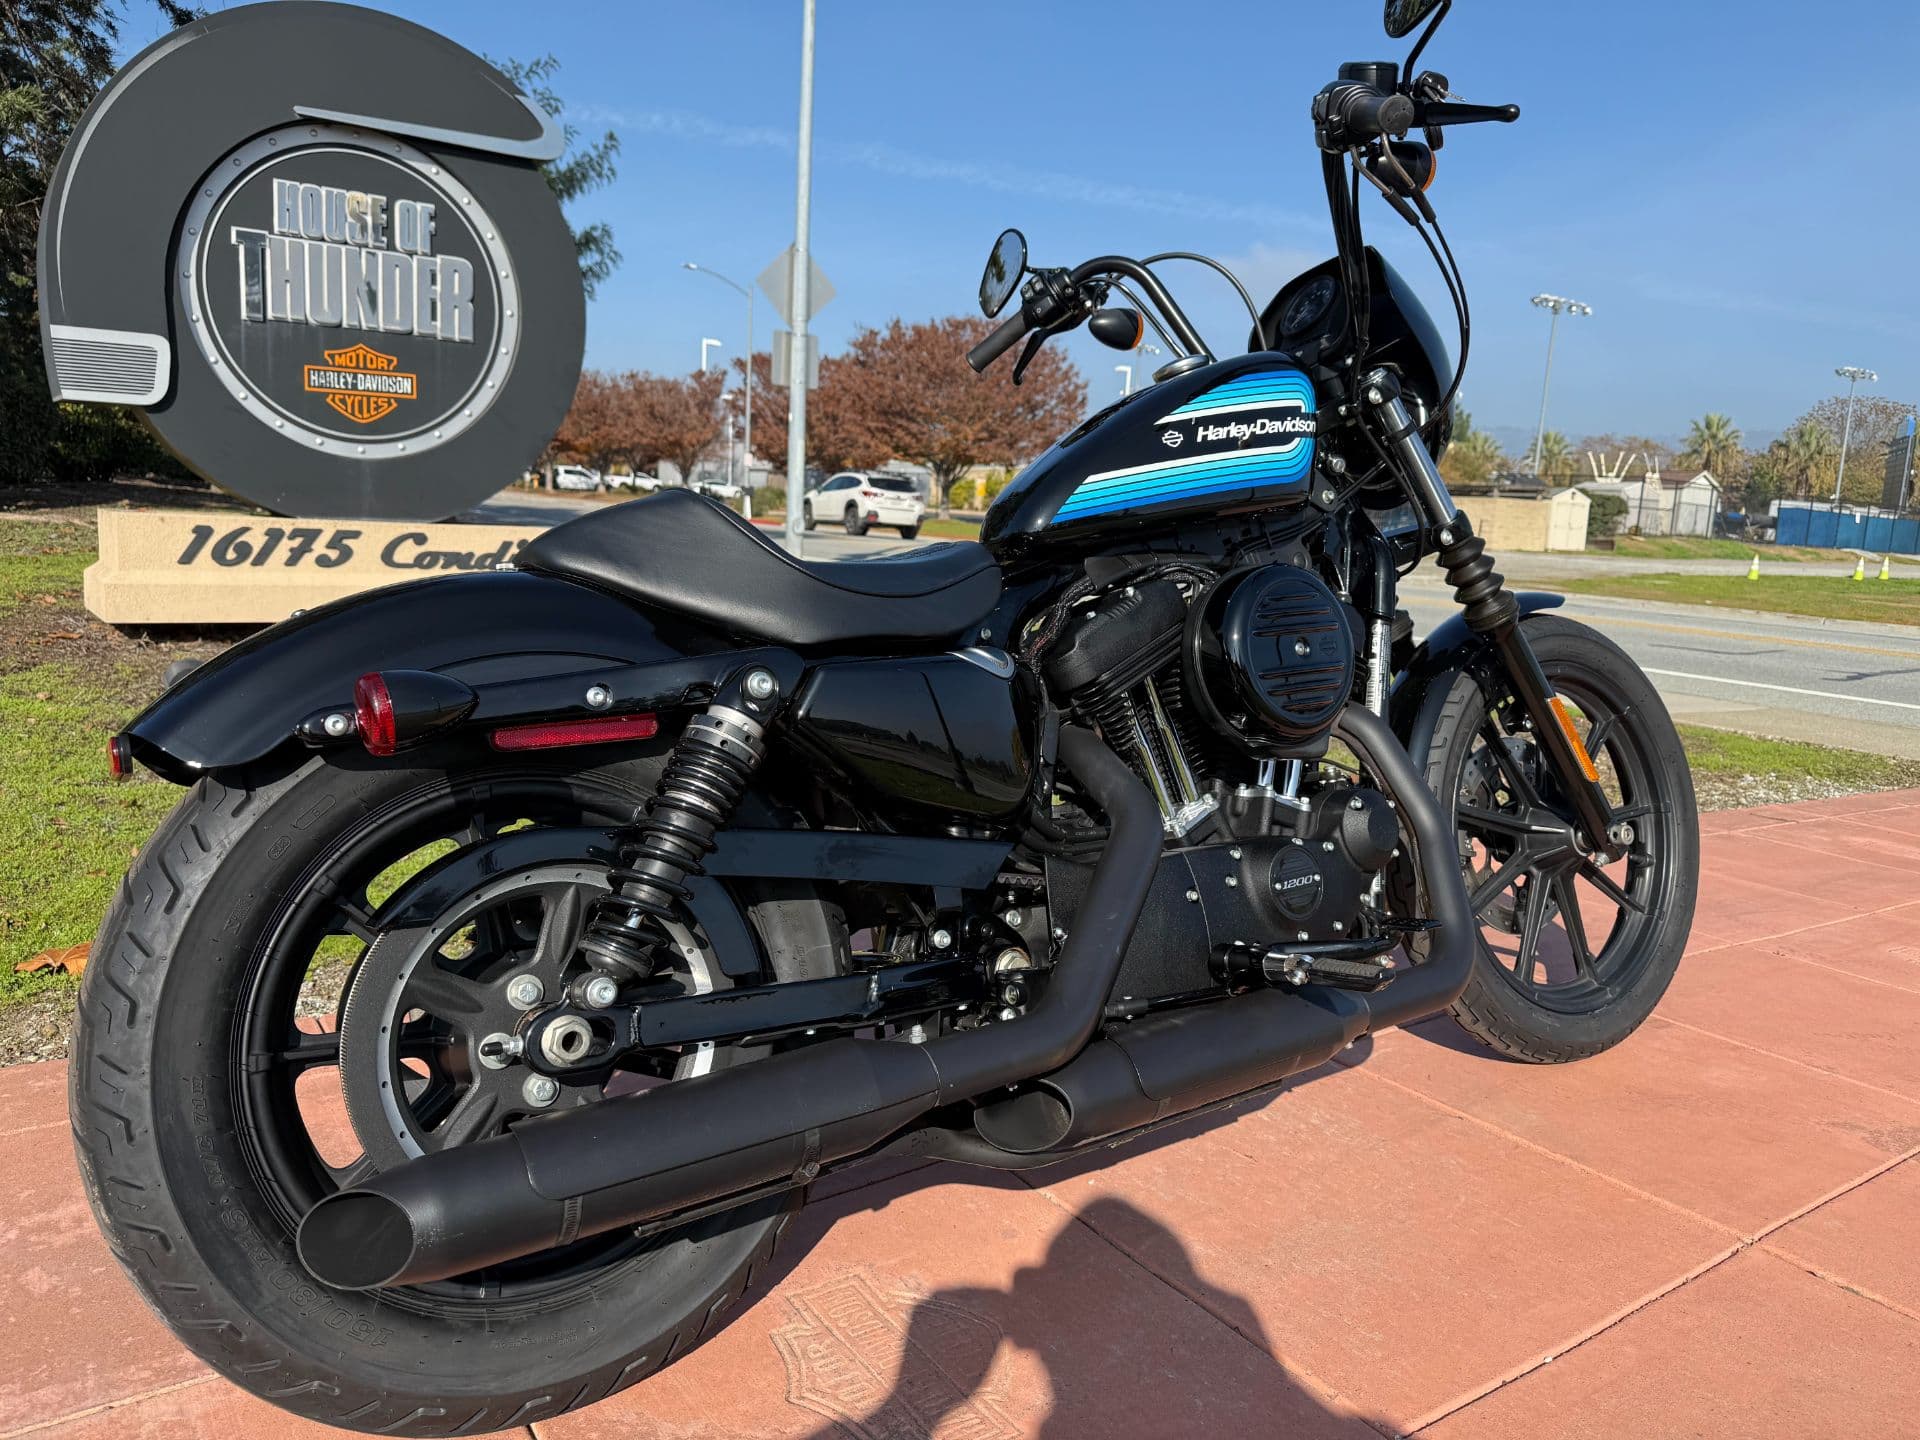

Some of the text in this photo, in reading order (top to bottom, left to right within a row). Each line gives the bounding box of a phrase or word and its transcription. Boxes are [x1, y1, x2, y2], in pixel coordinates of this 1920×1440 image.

[273, 178, 436, 255] HOUSE OF
[231, 226, 474, 343] THUNDER
[334, 349, 388, 370] MOTOR
[309, 369, 413, 395] HARLEY-DAVIDSON
[334, 394, 388, 419] CYCLES
[1196, 416, 1317, 443] Harley-Davidson
[177, 524, 363, 569] 16175
[1282, 874, 1313, 890] 1200
